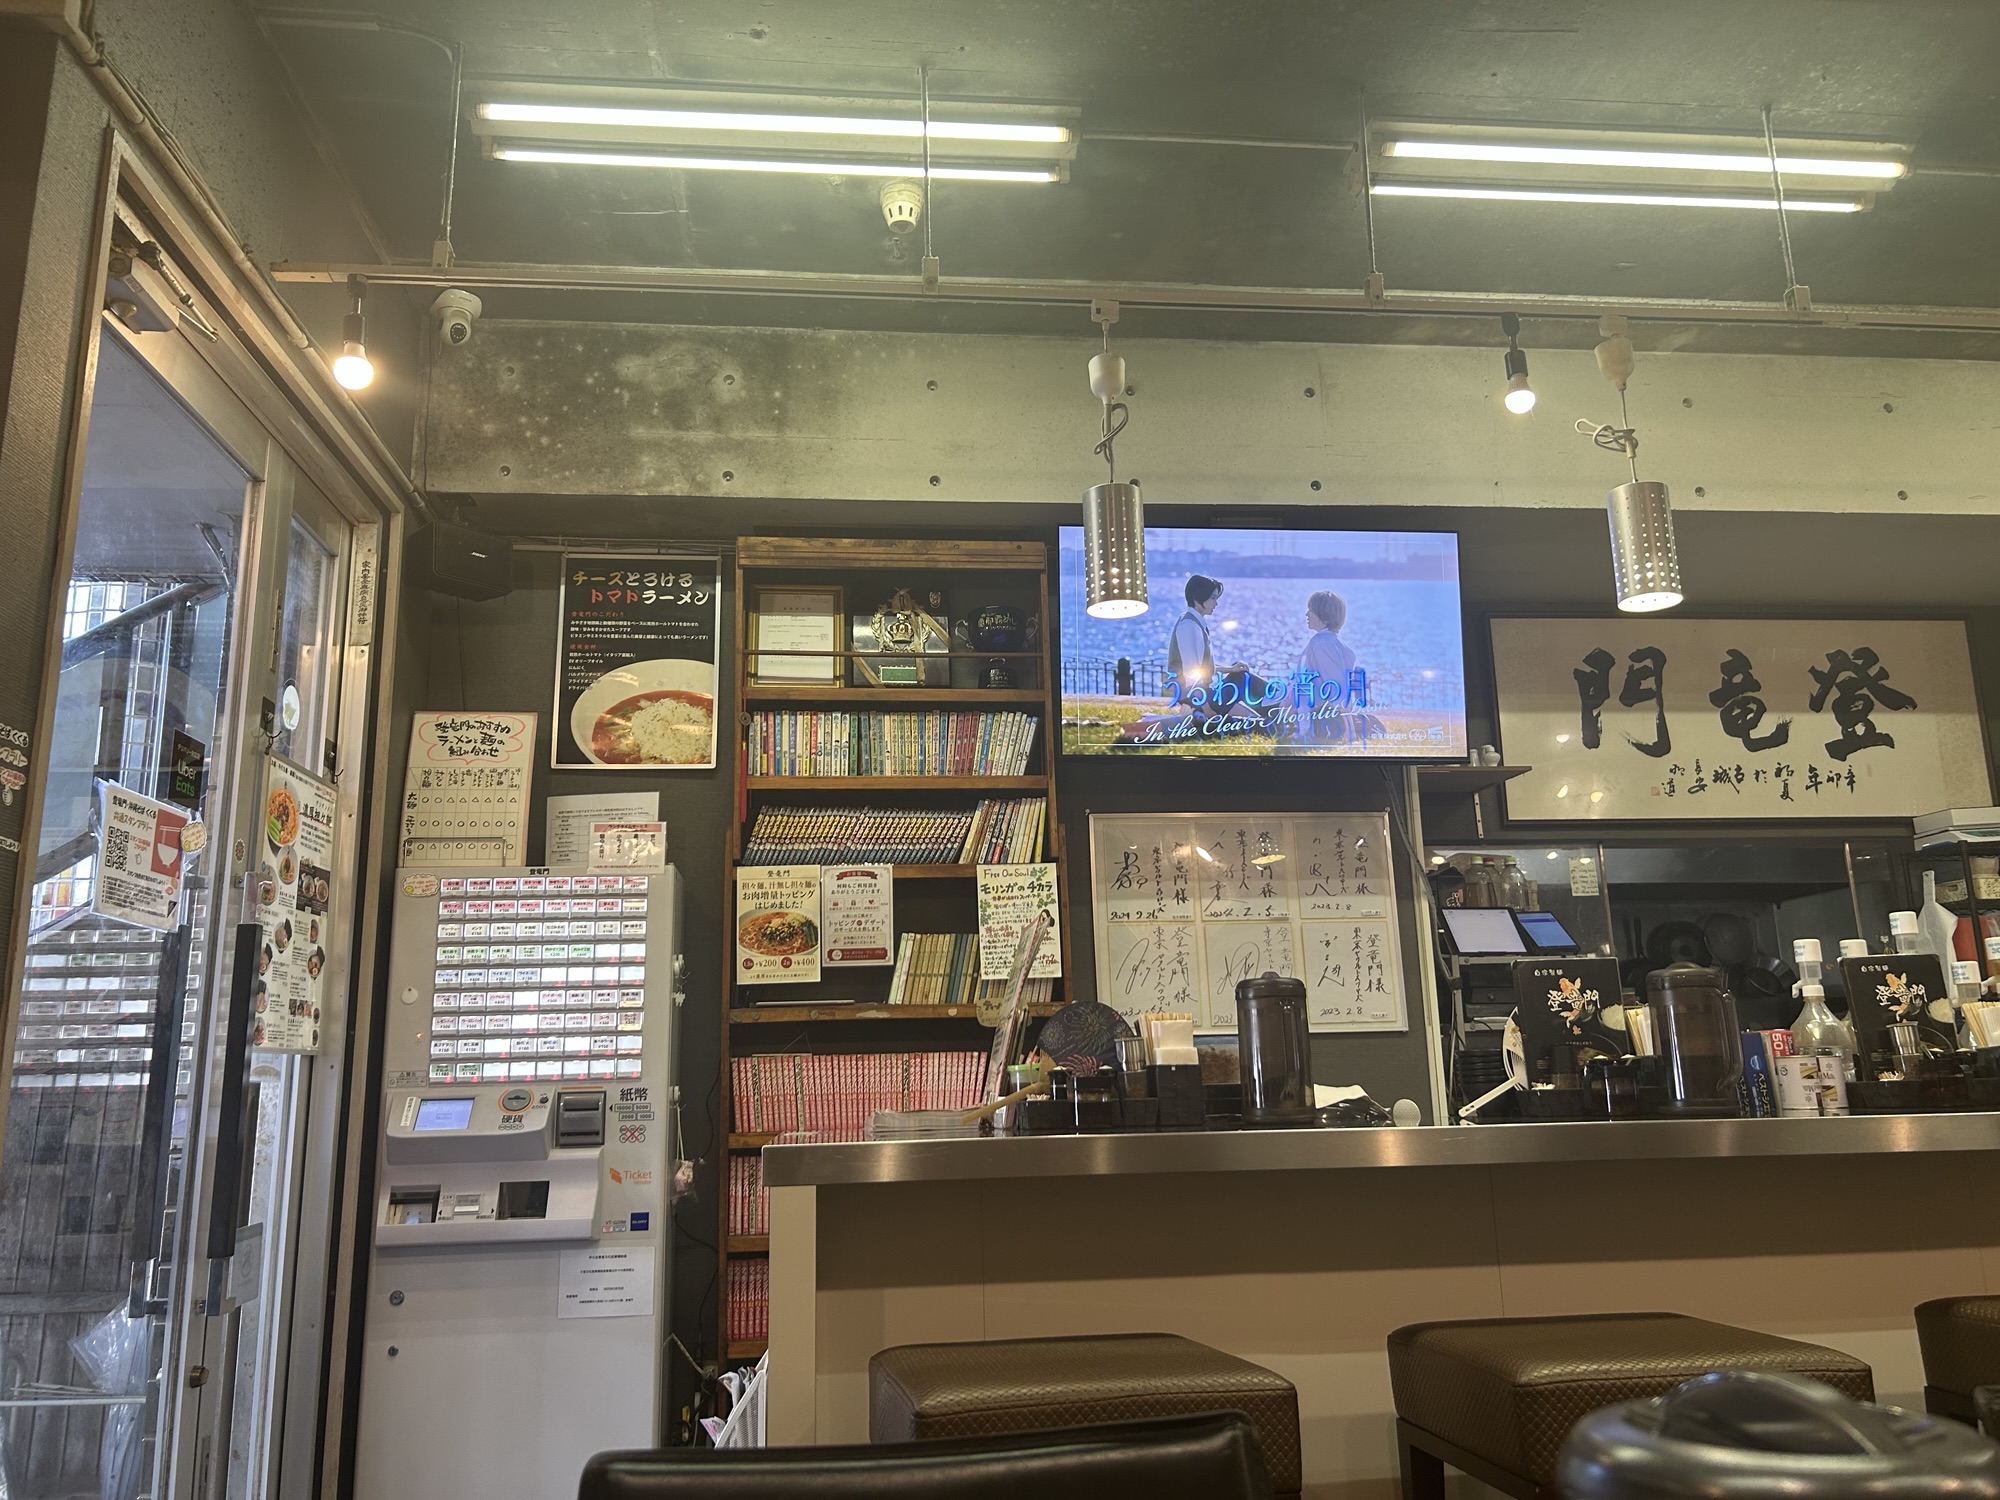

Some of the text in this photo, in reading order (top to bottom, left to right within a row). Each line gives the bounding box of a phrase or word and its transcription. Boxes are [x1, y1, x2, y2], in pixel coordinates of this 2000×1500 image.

[572, 571, 693, 587] チーズとろける
[591, 589, 709, 605] トマトラーメン
[1162, 667, 1367, 708] うるわしの宵の月
[1134, 722, 1164, 744] In
[1168, 715, 1197, 740] the
[1203, 711, 1255, 736] Clear
[1259, 701, 1340, 728] Moonlit
[437, 732, 505, 746] ラーメンと麺の
[448, 745, 499, 758] 組み合わせ
[178, 759, 196, 780] Uber
[176, 776, 195, 797] Eats
[983, 868, 1000, 879] Free
[1014, 868, 1030, 878] Soul
[980, 881, 1053, 894] モリンガのチカラ
[742, 890, 816, 900] お肉増量トッピング
[1320, 1008, 1340, 1017] 2023
[620, 1087, 648, 1101] 紙幣
[502, 1114, 524, 1123] 硬貨
[624, 1170, 652, 1179] Ticket
